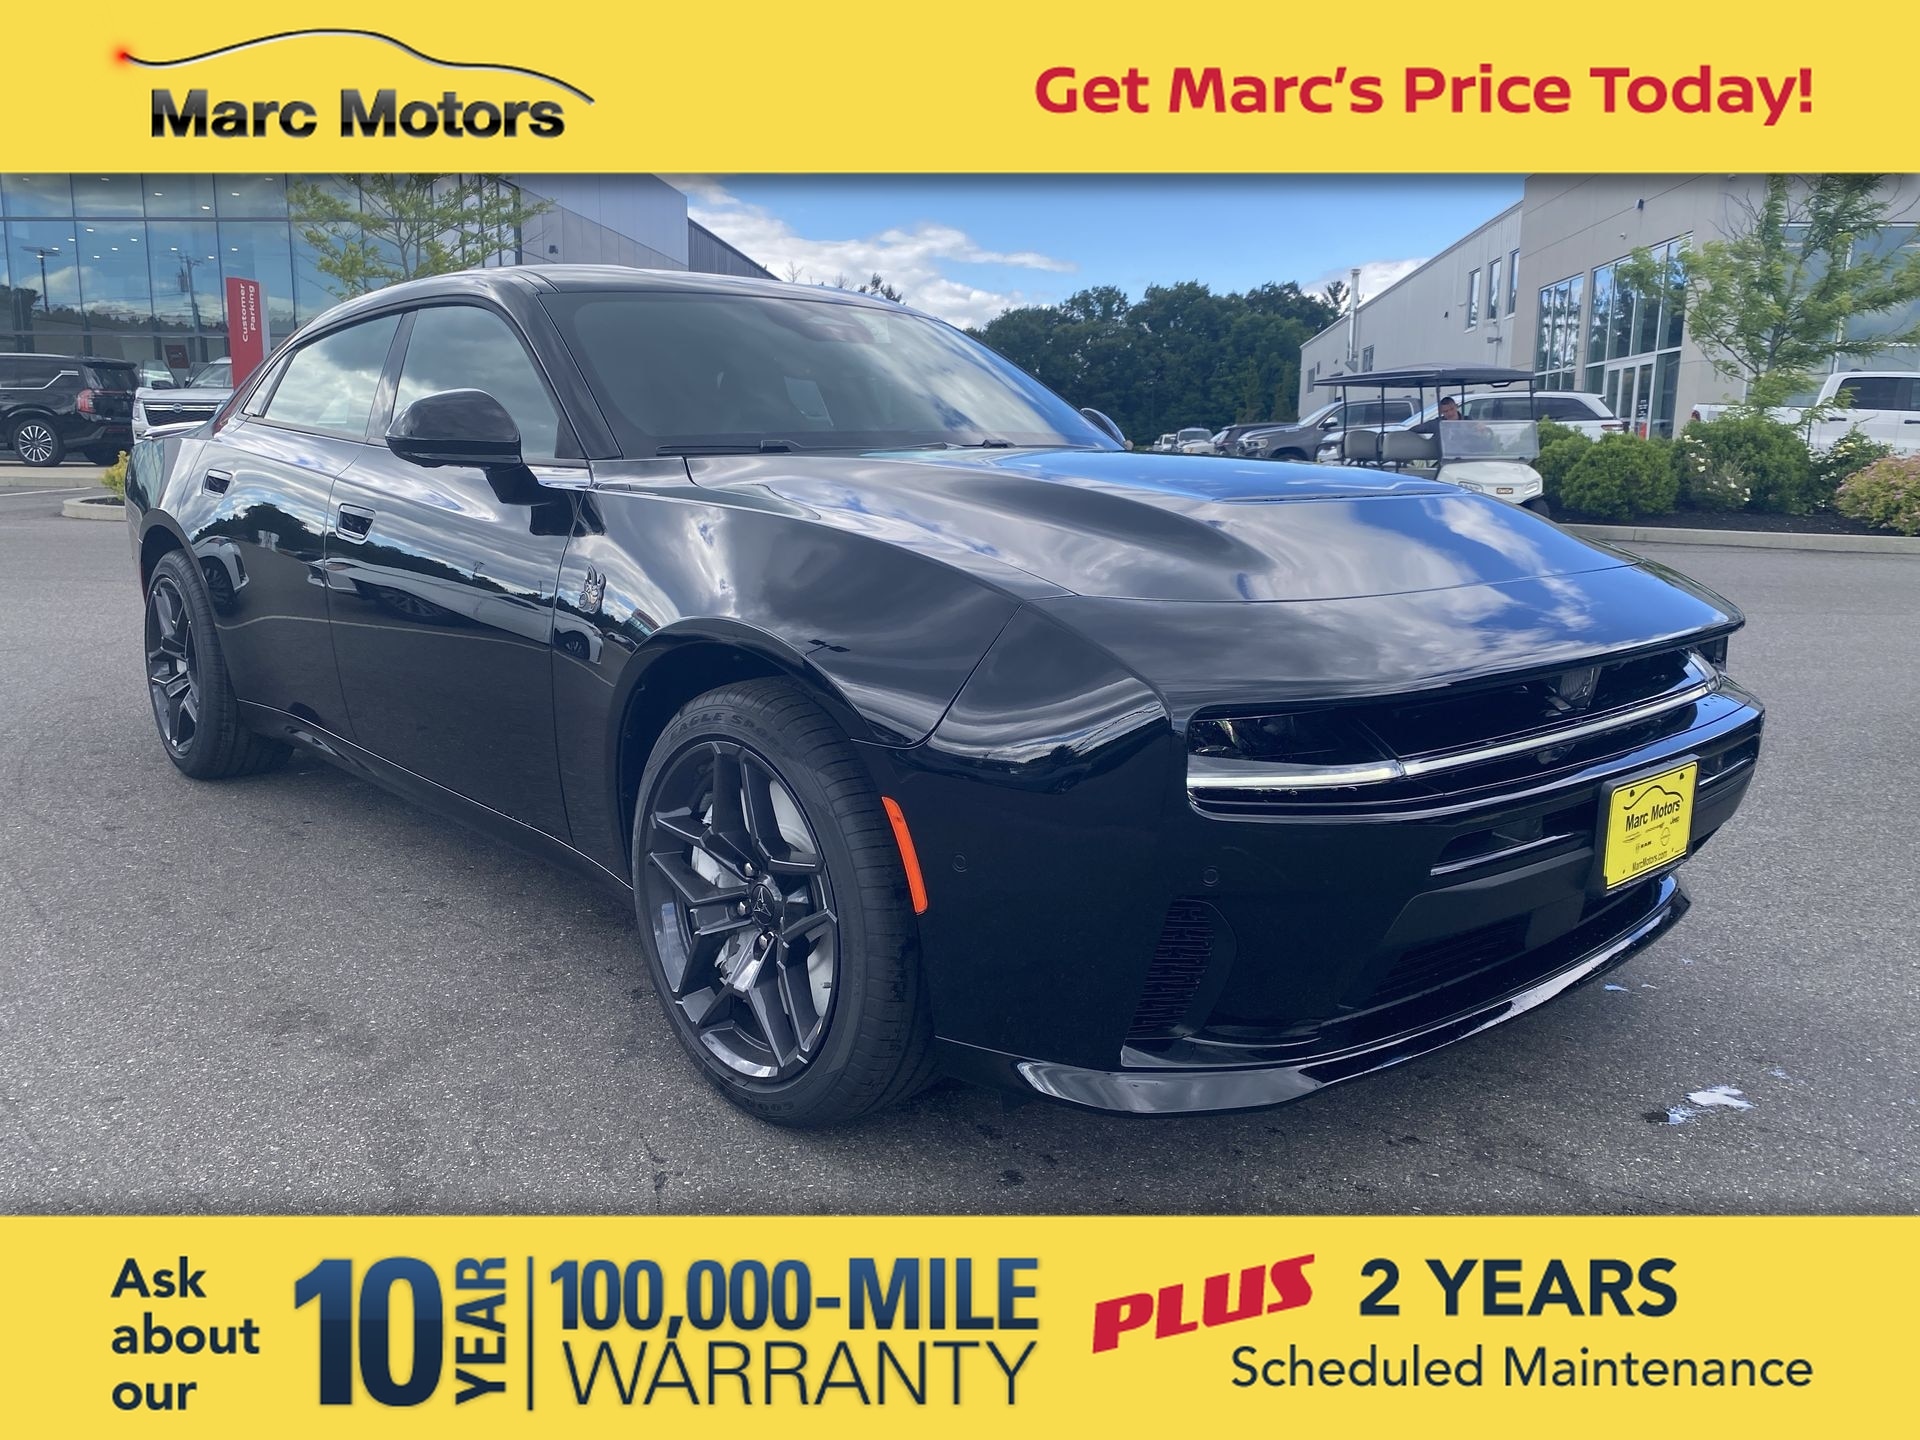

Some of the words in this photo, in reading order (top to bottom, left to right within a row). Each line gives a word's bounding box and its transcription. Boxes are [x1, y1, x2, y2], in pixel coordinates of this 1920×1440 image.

[240, 283, 249, 342] Customer
[248, 285, 256, 331] Parking
[670, 712, 725, 740] EAGLE
[1625, 813, 1648, 832] Marc
[1650, 800, 1680, 821] Motors
[1632, 851, 1668, 872] MarcMotors.com
